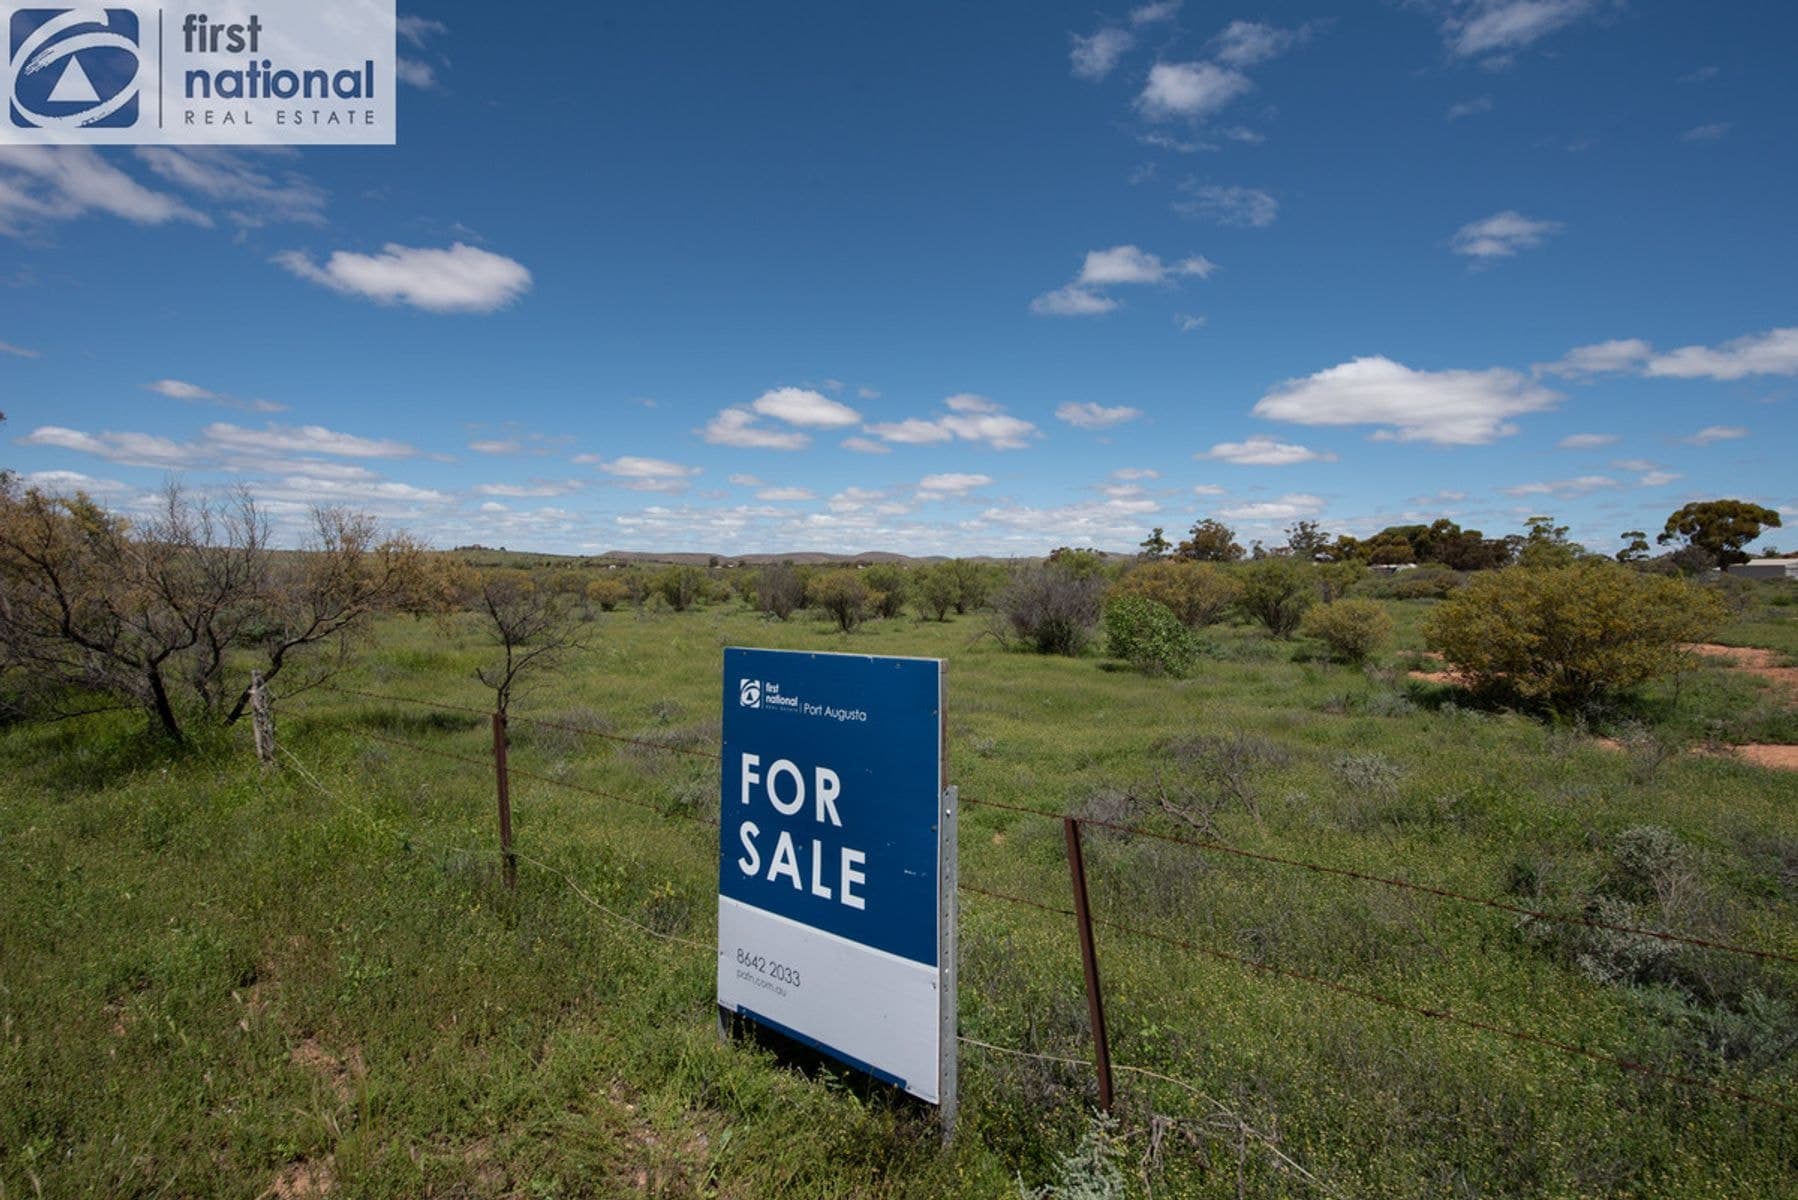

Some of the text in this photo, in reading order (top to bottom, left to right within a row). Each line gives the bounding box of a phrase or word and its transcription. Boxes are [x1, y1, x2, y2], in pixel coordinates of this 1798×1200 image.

[765, 682, 779, 693] first
[765, 694, 798, 707] national
[804, 702, 823, 716] Port
[824, 706, 867, 721] Augusta
[741, 752, 842, 827] FOR
[738, 821, 866, 910] SALE
[736, 948, 801, 987] 8642 2033
